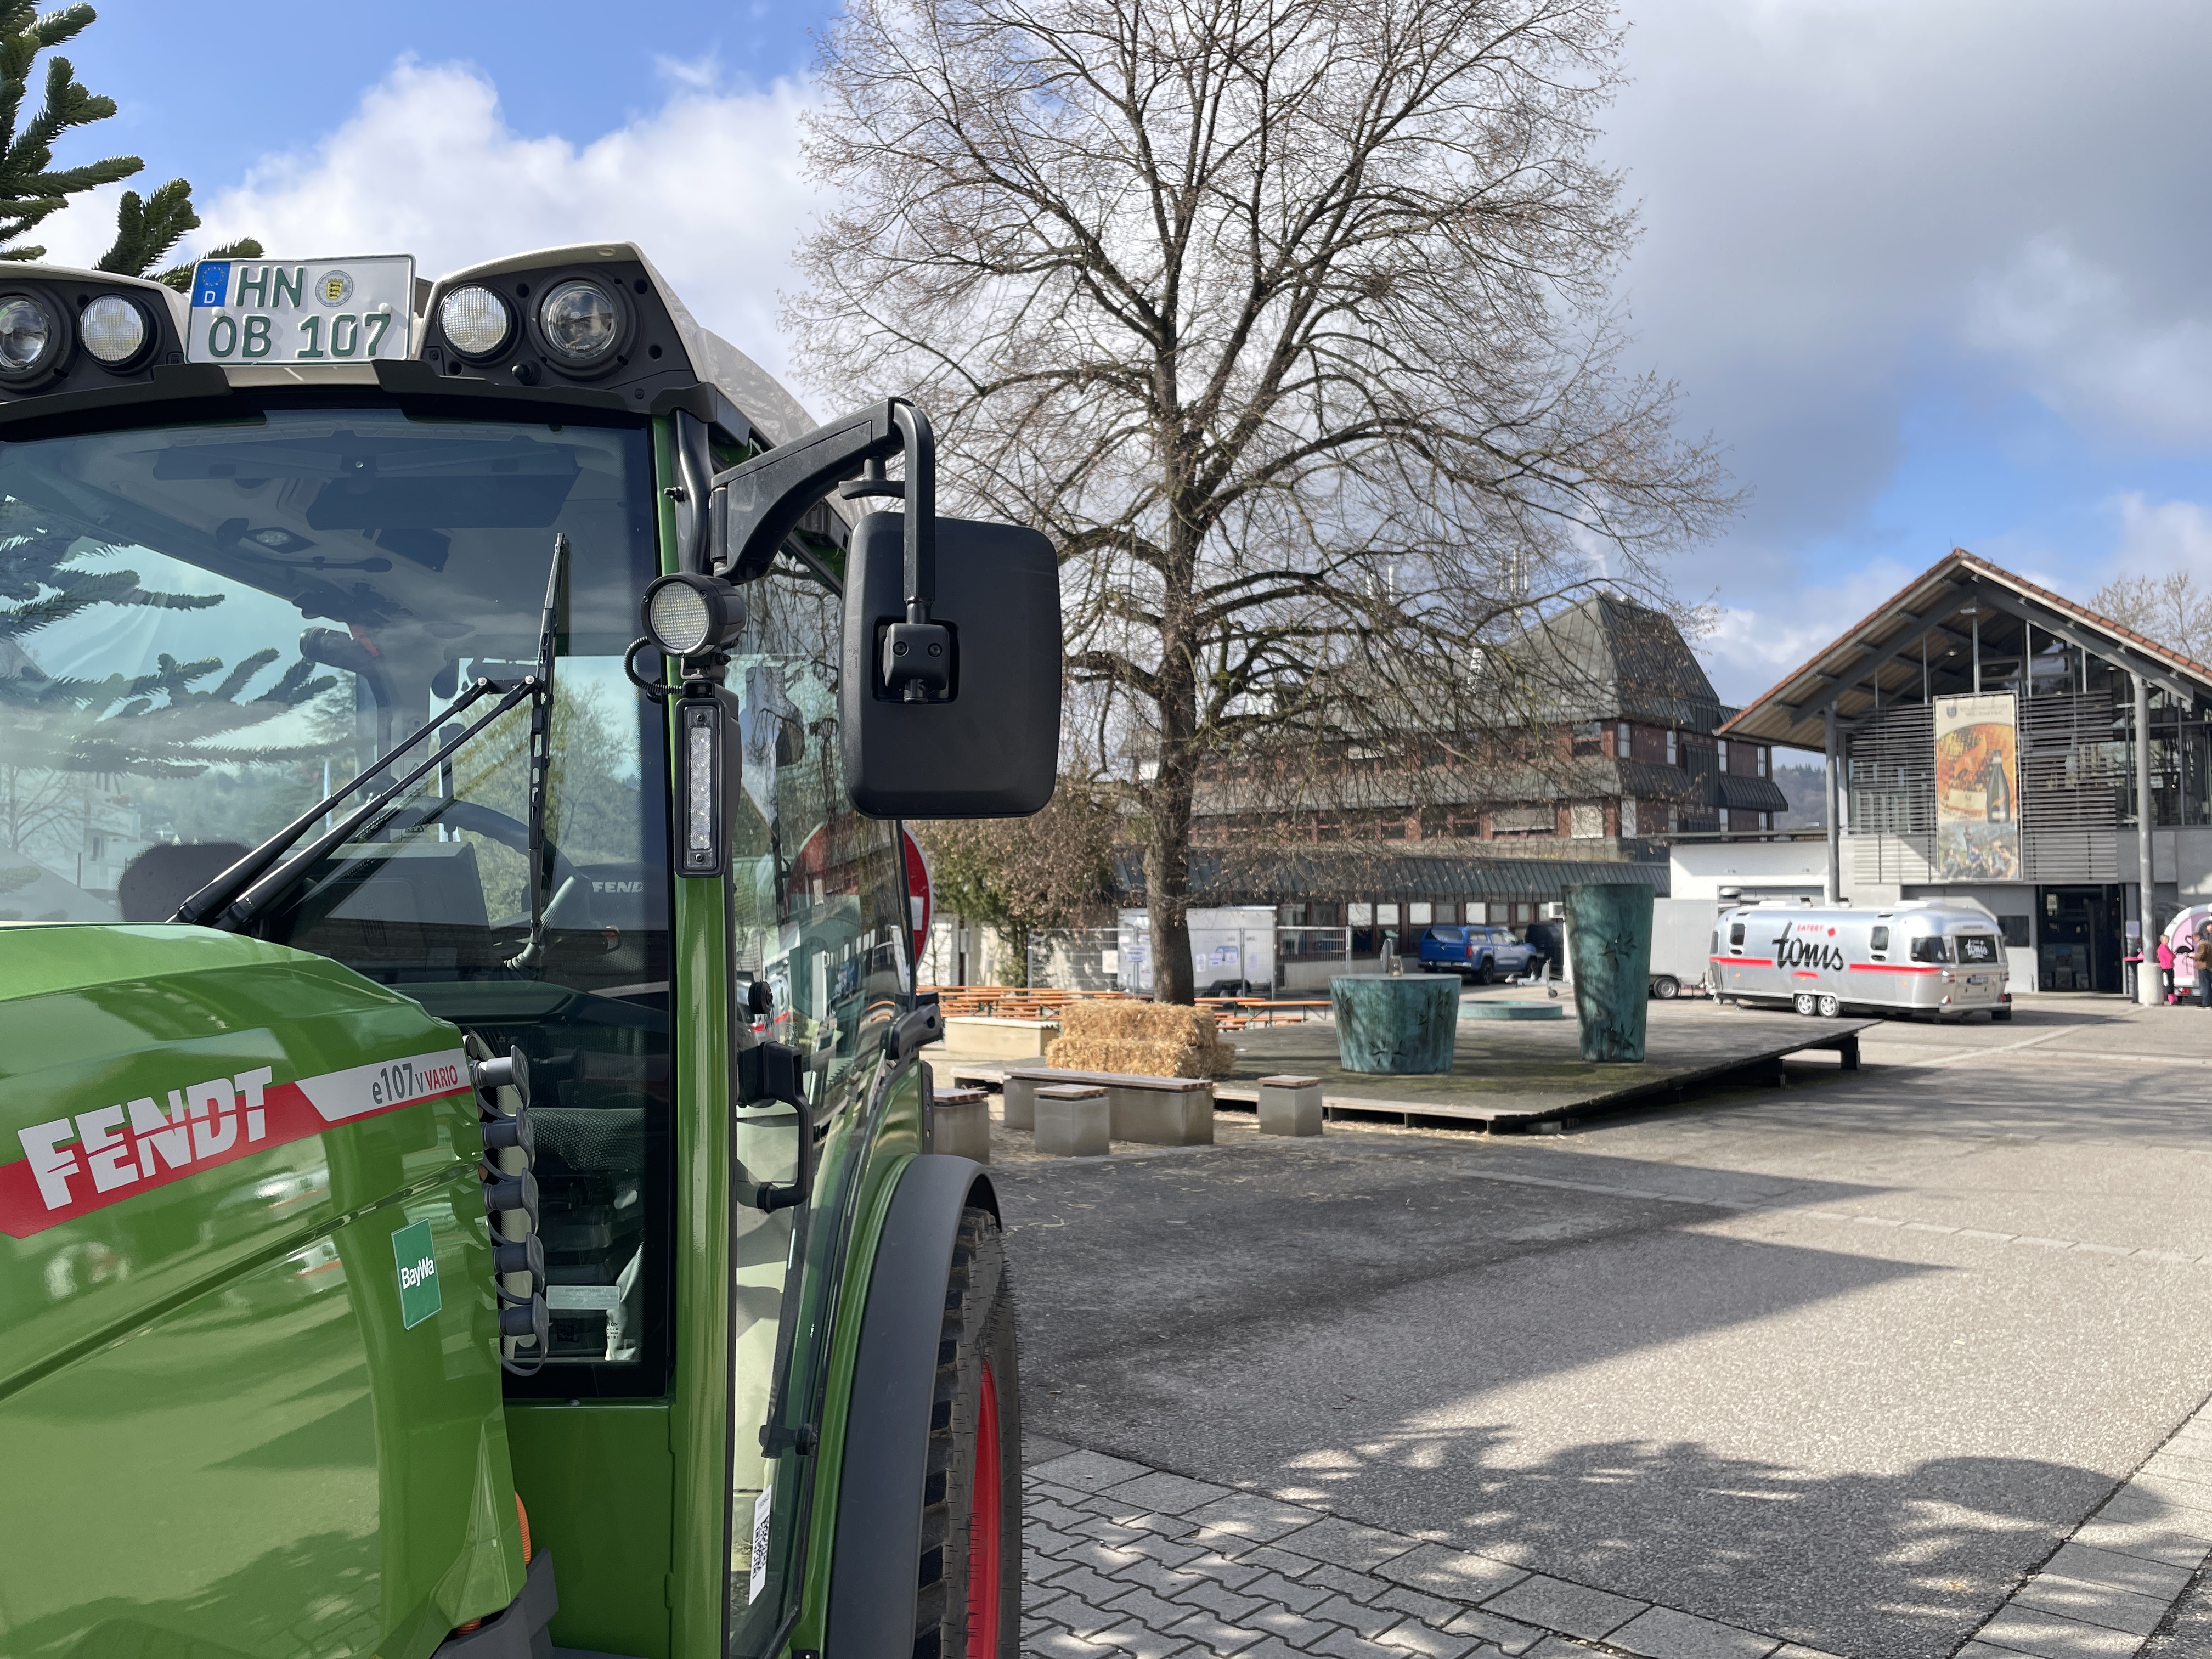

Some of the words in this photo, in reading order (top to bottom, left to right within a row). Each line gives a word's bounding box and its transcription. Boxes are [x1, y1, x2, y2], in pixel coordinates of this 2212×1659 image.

[204, 291, 216, 304] D
[234, 266, 306, 308] HN
[208, 314, 272, 358] OB
[296, 312, 392, 358] 107
[1797, 924, 1824, 932] EATERY
[424, 1065, 458, 1091] VARIO
[17, 1065, 273, 1211] FENDT
[400, 1256, 435, 1289] BayWa
